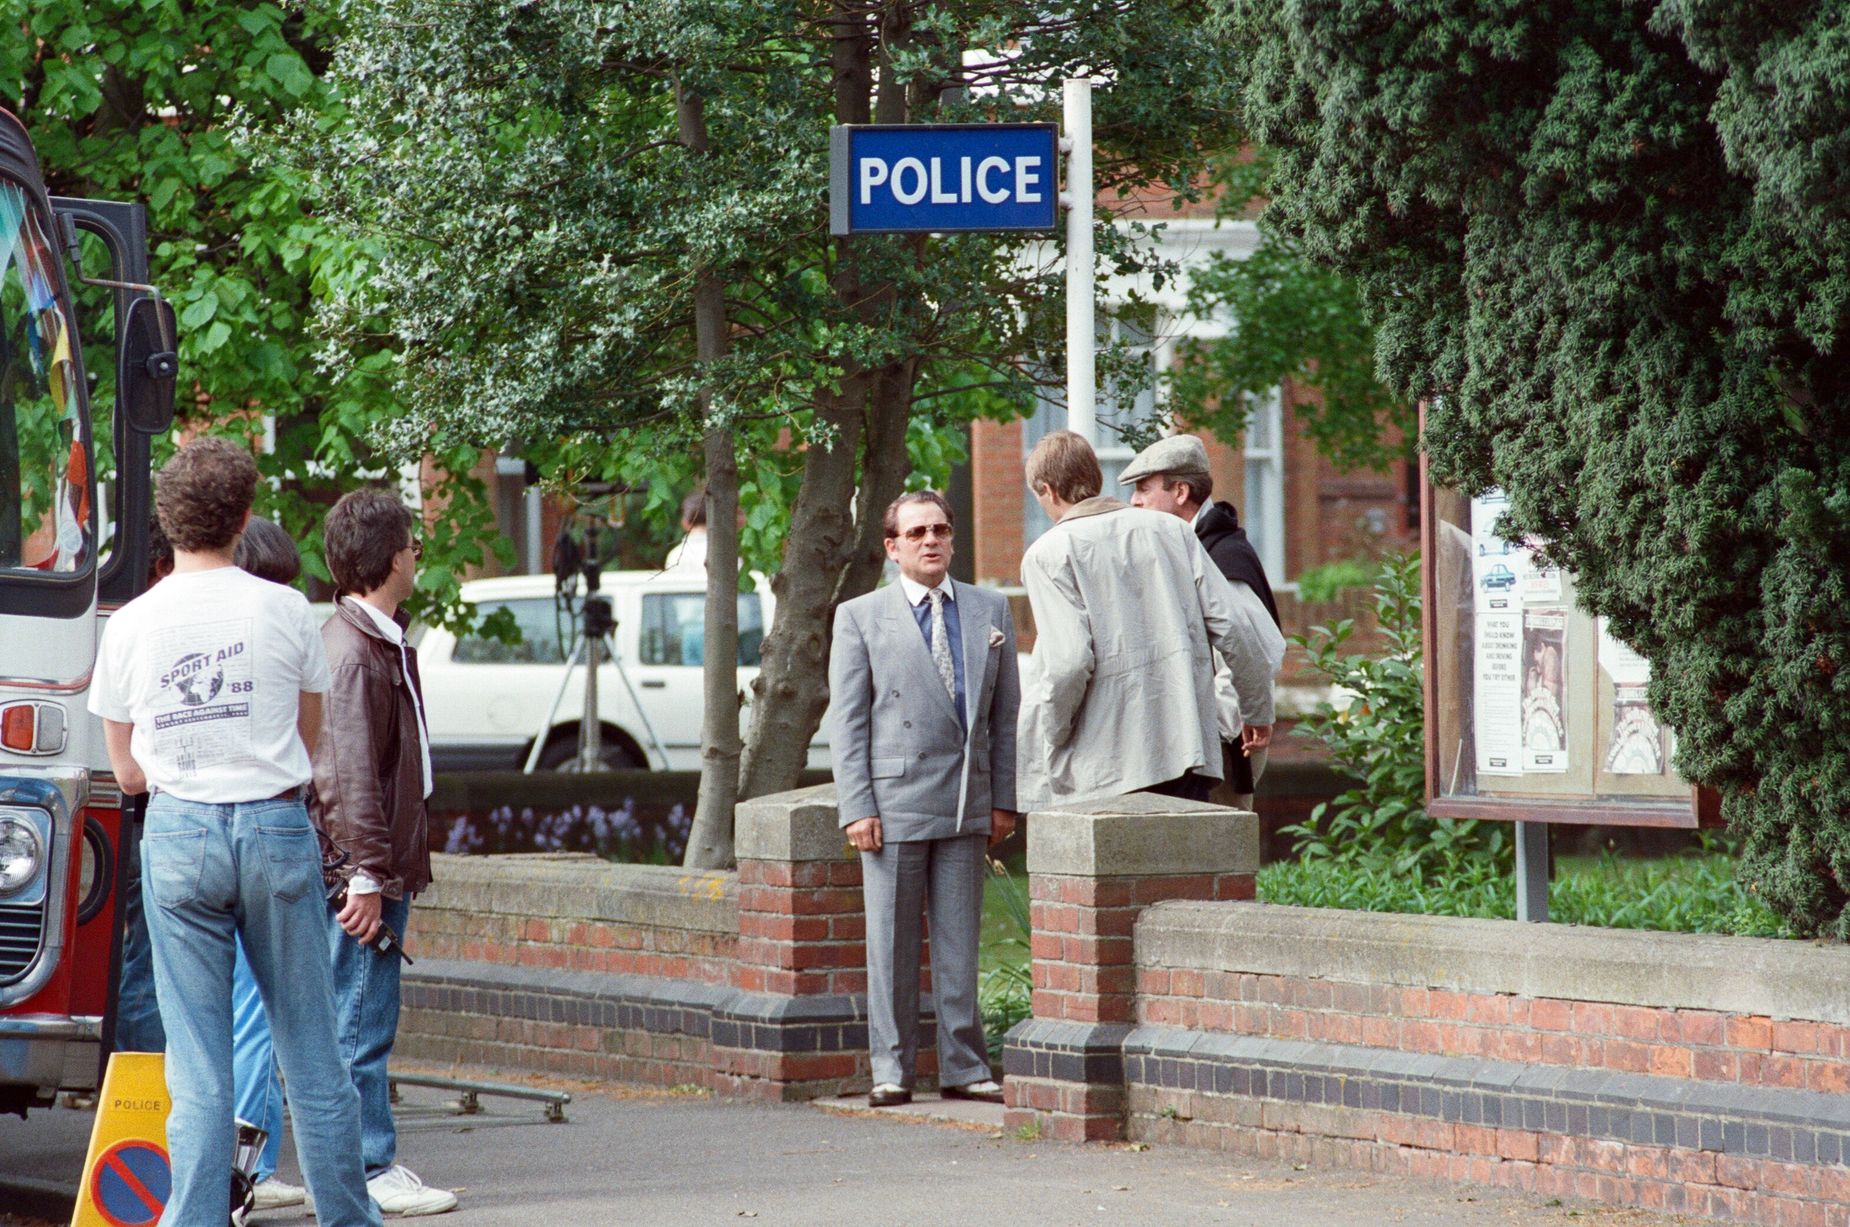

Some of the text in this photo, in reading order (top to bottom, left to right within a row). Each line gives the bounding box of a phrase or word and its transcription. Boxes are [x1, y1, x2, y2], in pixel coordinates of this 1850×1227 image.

[860, 156, 1042, 205] POLICE
[160, 642, 244, 689] SPORT AID
[155, 714, 171, 724] THE
[172, 710, 193, 720] RACE
[193, 706, 227, 717] AGAINST
[228, 704, 248, 713] TIME
[114, 1099, 161, 1111] POLICE
